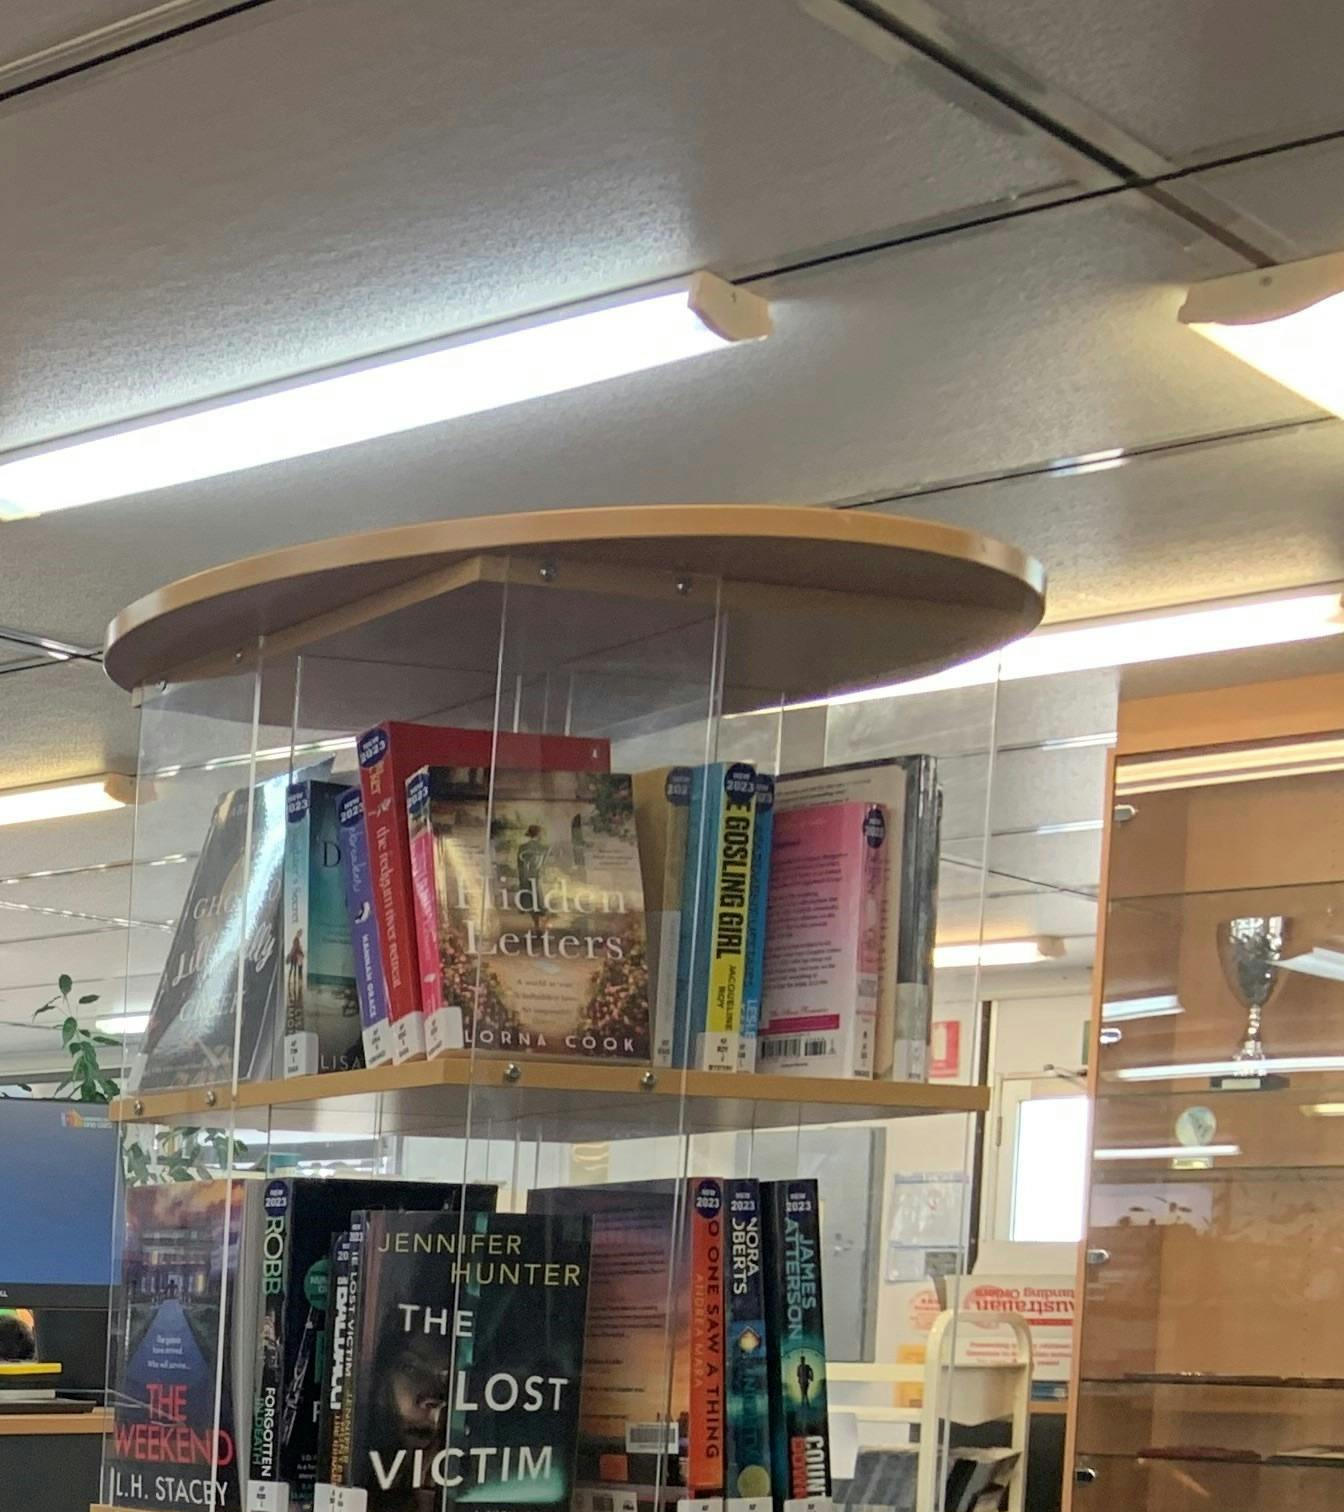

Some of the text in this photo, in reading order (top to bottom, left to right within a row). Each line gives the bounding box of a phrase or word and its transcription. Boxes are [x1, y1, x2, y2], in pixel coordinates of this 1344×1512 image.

[360, 740, 387, 764] 2023
[726, 781, 755, 792] 2023
[376, 826, 390, 852] the
[455, 877, 626, 914] Hidden
[715, 816, 751, 960] GOSLING GIRL
[465, 919, 625, 961] Letters
[717, 985, 726, 1009] ROY
[724, 964, 737, 1032] JACQUELINE
[464, 1028, 635, 1052] LORNA COOK
[319, 1055, 362, 1071] LISA
[265, 1197, 287, 1208] 2023
[696, 1197, 720, 1209] 2023
[730, 1200, 756, 1212] 2023
[786, 1200, 812, 1212] 2023
[790, 1192, 806, 1200] NEW
[262, 1216, 284, 1296] ROBB
[377, 1232, 523, 1256] JENNIFER
[746, 1216, 760, 1277] NORA
[450, 1262, 581, 1288] HUNTER
[785, 1217, 803, 1340] ATTERSON
[799, 1234, 817, 1310] JAMES
[346, 1271, 358, 1378] LOST VICTIM
[398, 1303, 474, 1338] THE
[706, 1247, 720, 1460] ONE SAW A THING
[145, 1383, 188, 1422] THE
[455, 1370, 570, 1413] LOST
[114, 1423, 236, 1467] WEEKEND
[261, 1386, 276, 1478] FORGOTTEN
[368, 1445, 553, 1491] VICTIM
[115, 1473, 229, 1507] L.H. STACEY
